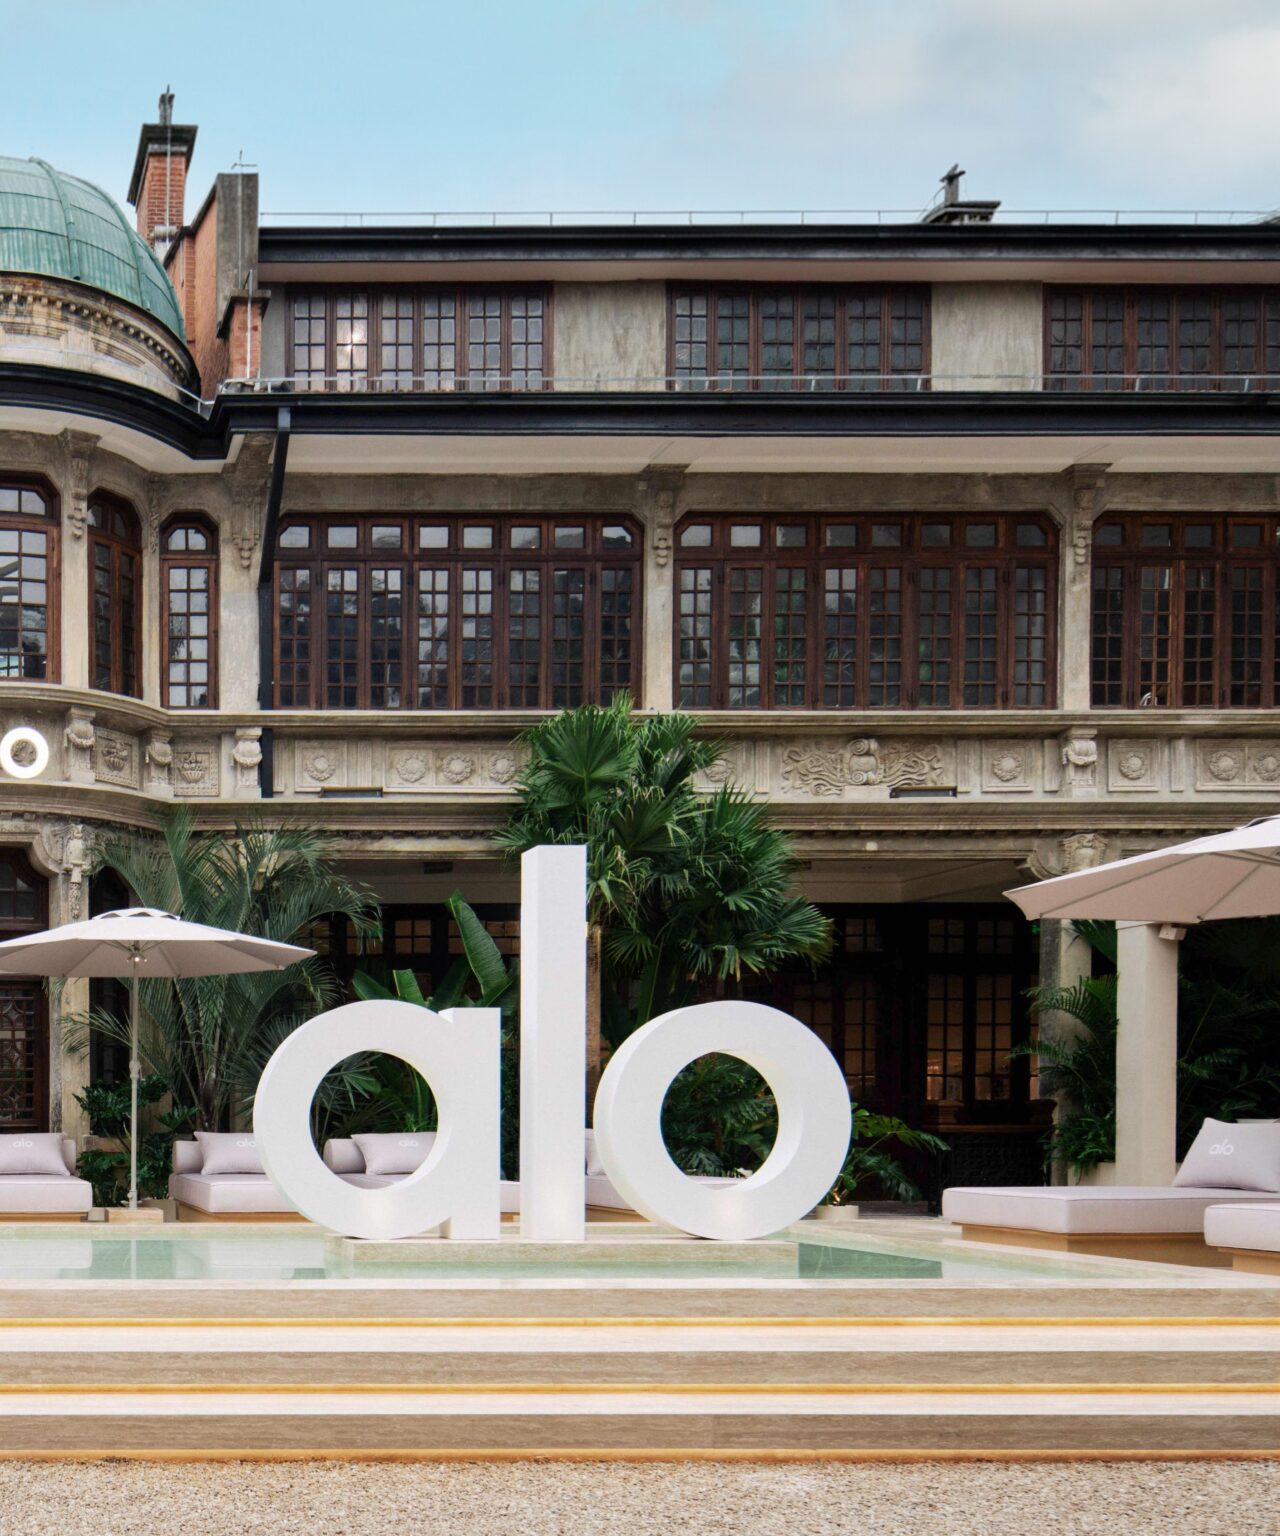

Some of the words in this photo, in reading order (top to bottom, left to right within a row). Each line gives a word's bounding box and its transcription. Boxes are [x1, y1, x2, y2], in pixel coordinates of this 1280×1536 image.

[252, 844, 852, 1241] alo
[12, 1137, 33, 1148] alo
[1209, 1138, 1234, 1155] alo
